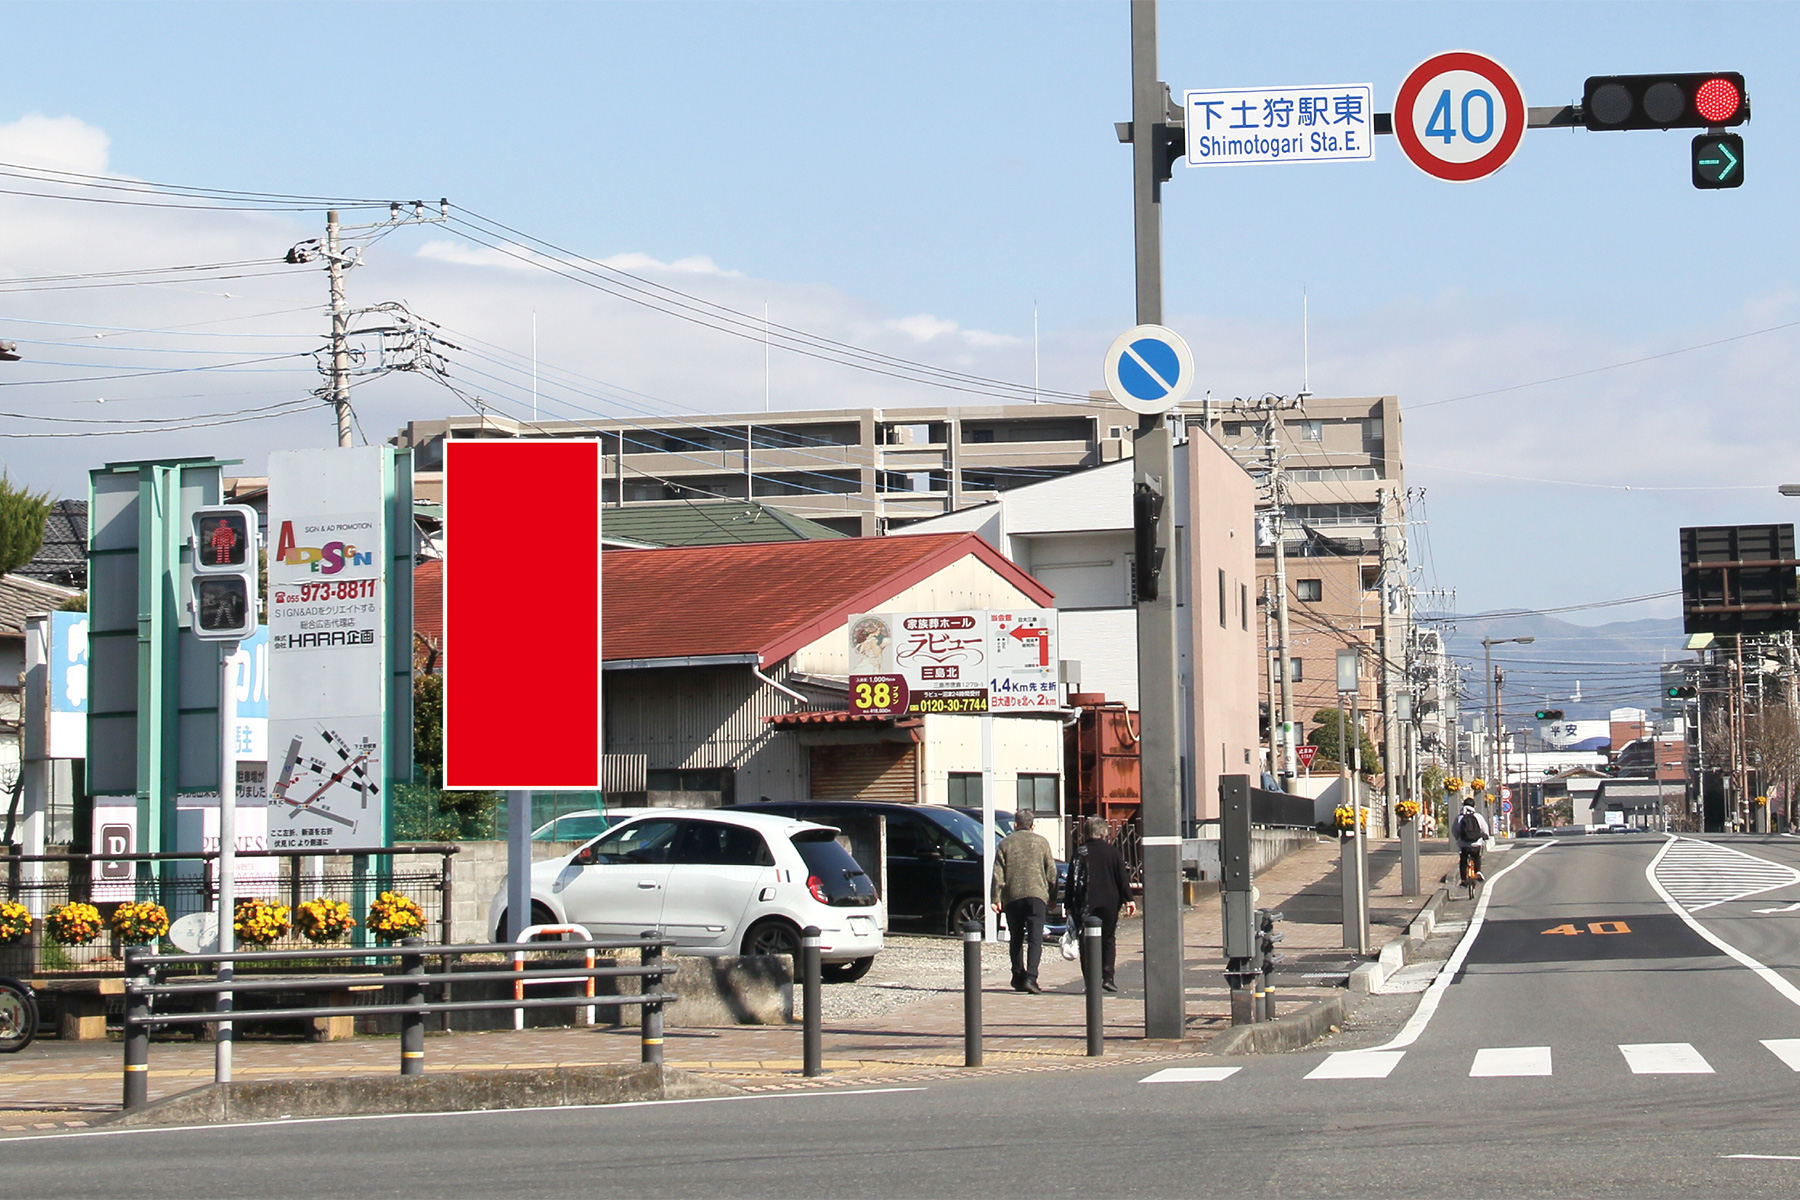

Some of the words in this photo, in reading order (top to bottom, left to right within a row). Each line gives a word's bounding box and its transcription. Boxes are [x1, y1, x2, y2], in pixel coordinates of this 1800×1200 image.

[1194, 94, 1365, 131] 下土狩駅東
[1425, 89, 1494, 144] 40
[1200, 133, 1303, 157] Shimotogari
[336, 522, 372, 530] PROMOTION
[286, 595, 300, 603] 055
[300, 579, 376, 602] 973-8811
[906, 617, 972, 630] 家族葬ホール
[901, 633, 982, 657] ラビュー
[923, 667, 958, 678] 三島北
[855, 683, 891, 709] 38
[920, 698, 987, 712] 0120-30-7744
[1550, 723, 1578, 737] 平安
[236, 786, 266, 798] りました
[1541, 921, 1632, 936] 40
